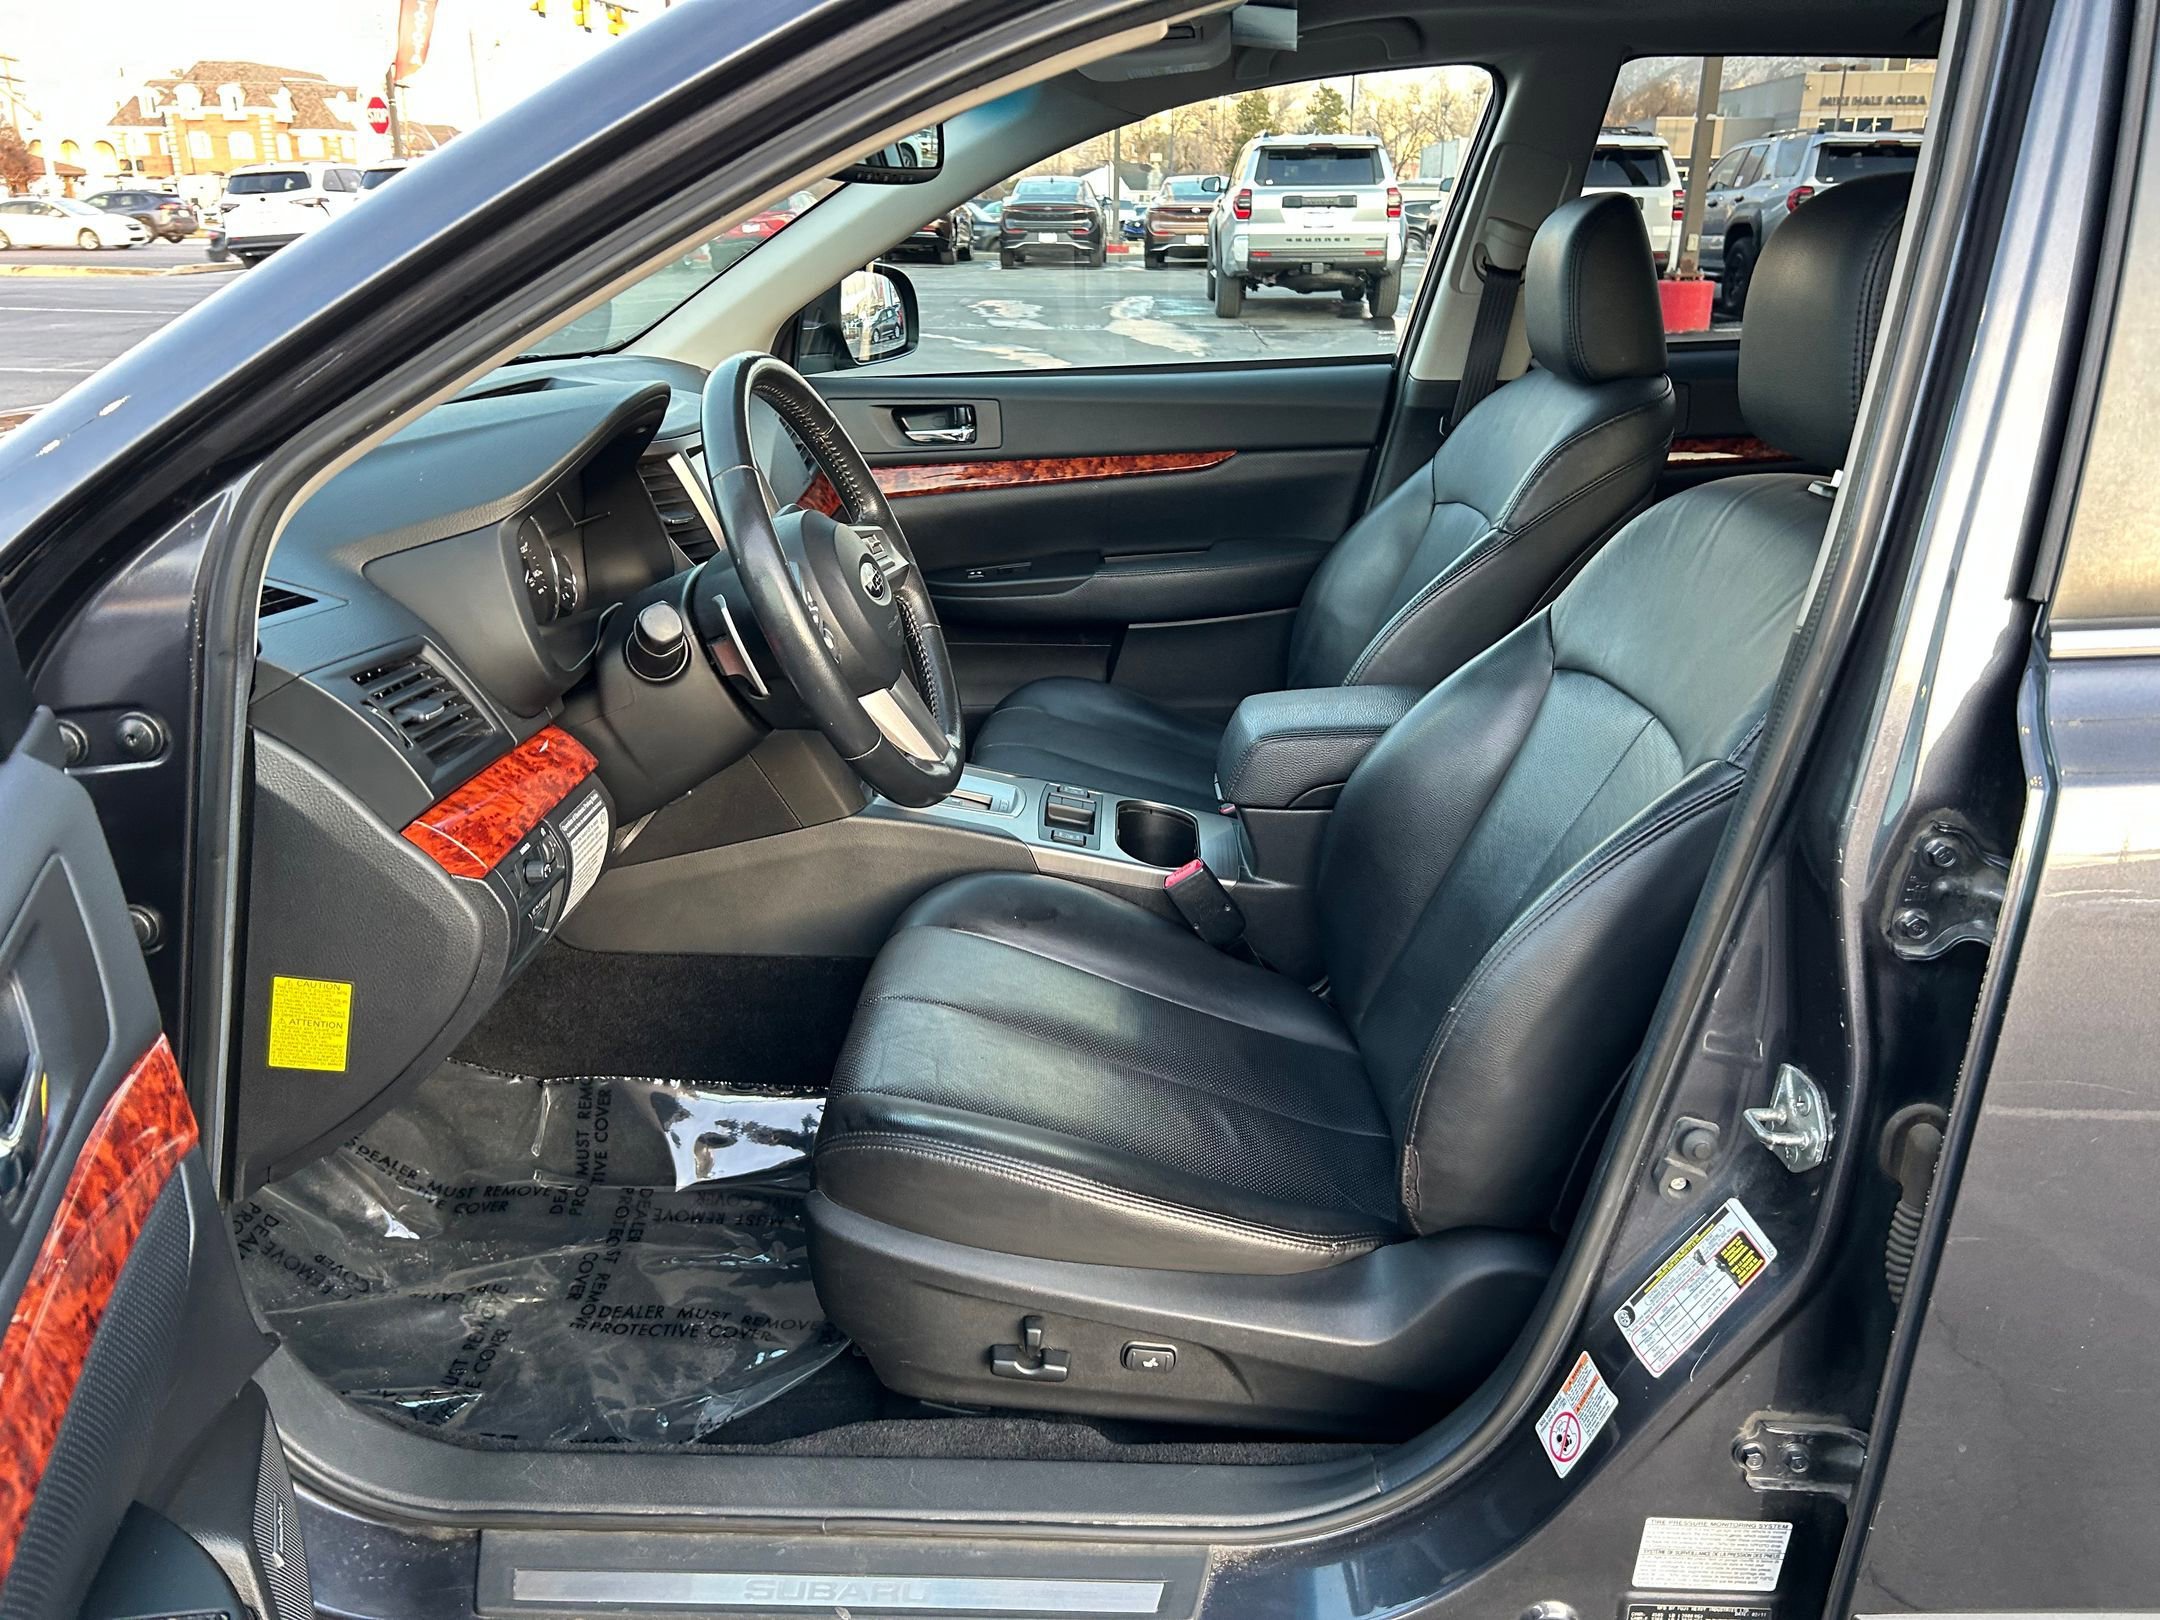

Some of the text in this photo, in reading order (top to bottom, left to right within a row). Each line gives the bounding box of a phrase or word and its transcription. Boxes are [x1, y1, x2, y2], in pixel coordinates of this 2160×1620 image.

[1884, 95, 1927, 106] ACURA
[367, 108, 388, 123] STOP
[296, 980, 341, 991] CAUTION
[289, 1018, 343, 1029] ATTENTION
[576, 1076, 592, 1119] REMO
[594, 1088, 611, 1142] COVER
[575, 1130, 589, 1175] MUST
[359, 1143, 418, 1181] DEALER
[427, 1179, 475, 1198] MUST
[454, 1200, 509, 1215] COVER
[597, 1304, 818, 1331] DEALER MUST REMOVE
[590, 1321, 771, 1342] PROTECTIVE COVER
[1710, 1521, 1757, 1529] MONITORING
[744, 1578, 931, 1603] SUBARU
